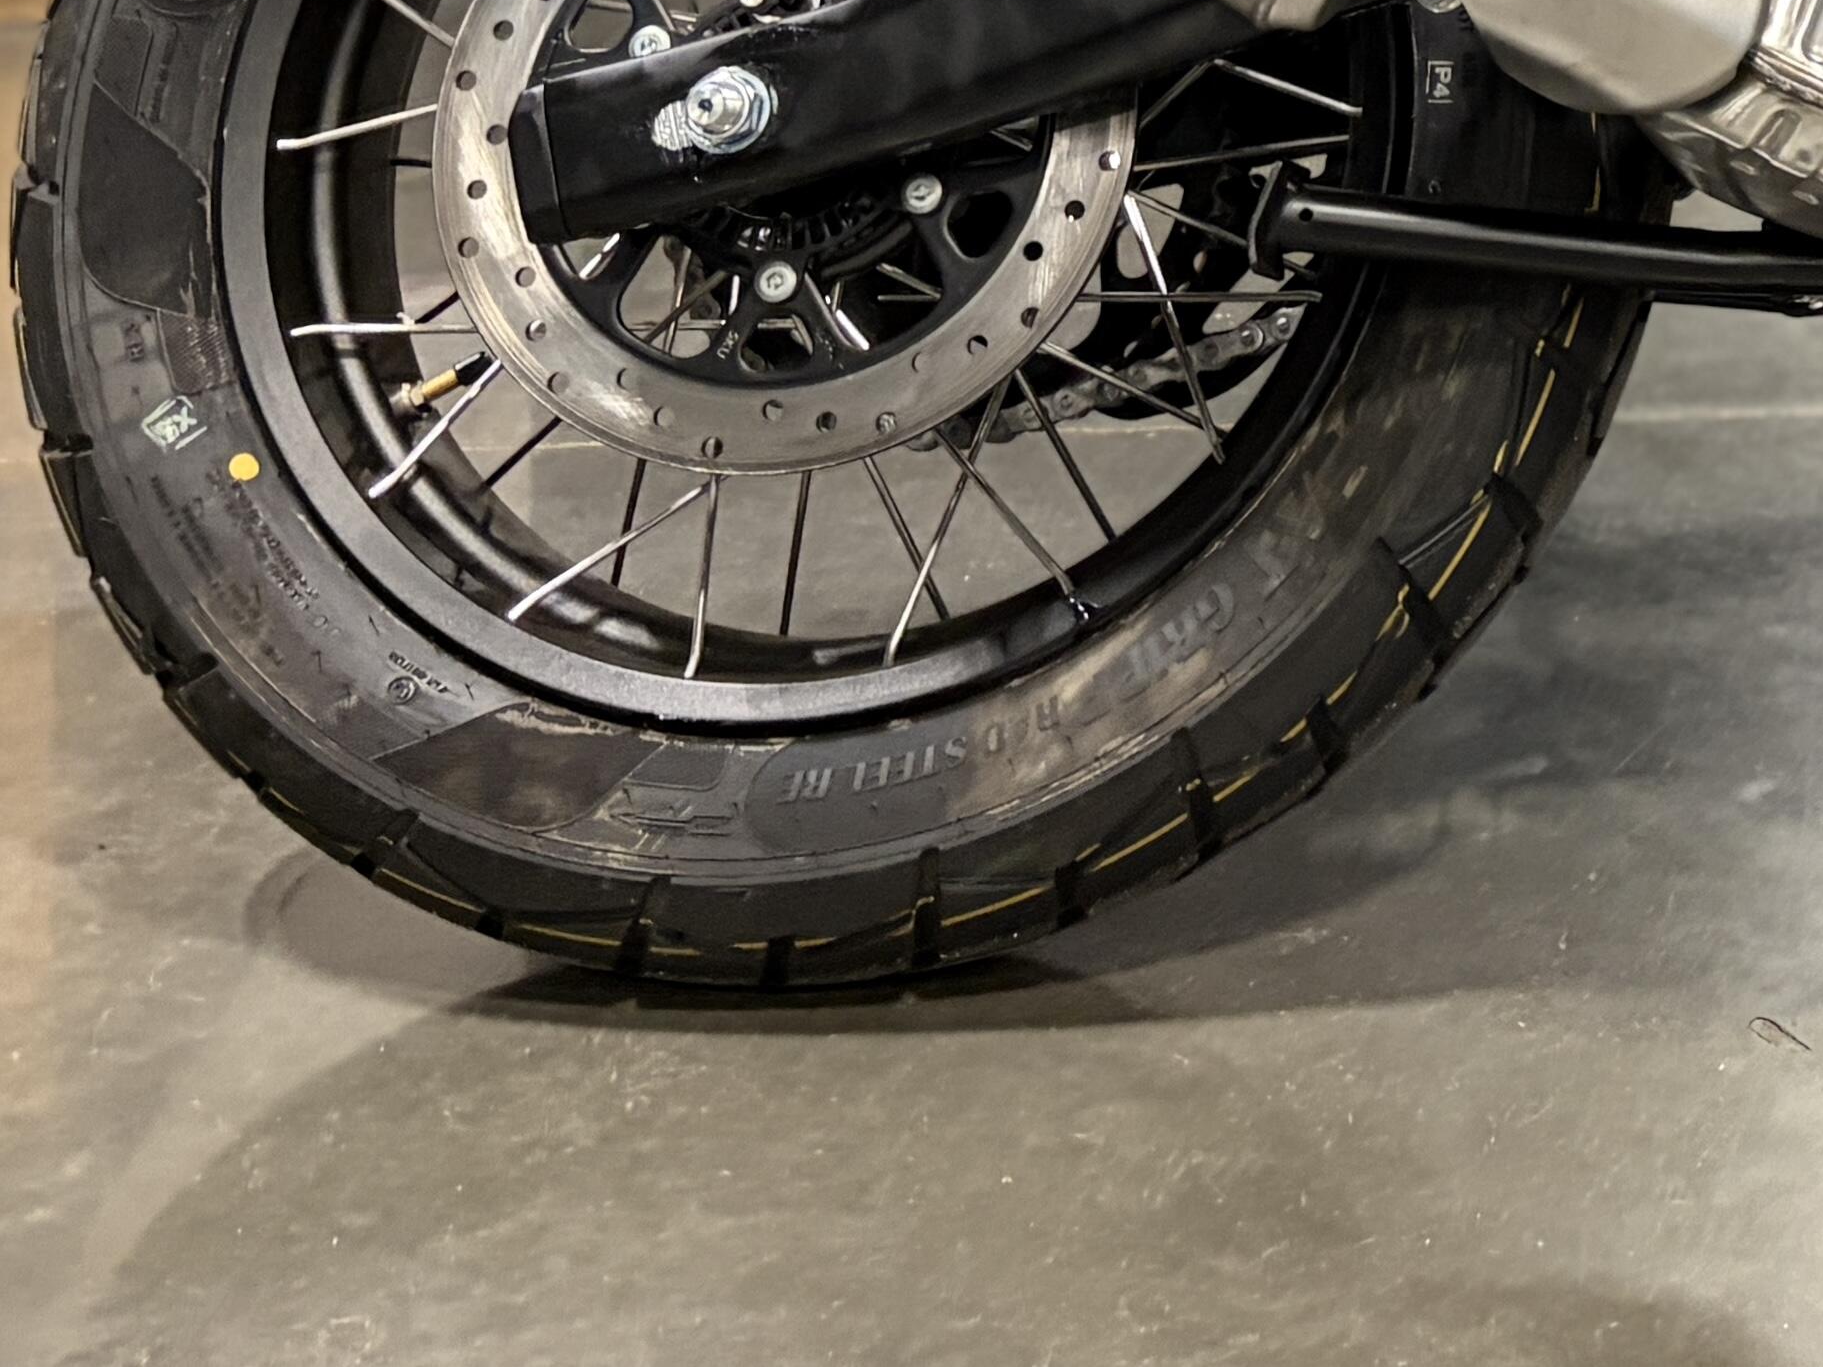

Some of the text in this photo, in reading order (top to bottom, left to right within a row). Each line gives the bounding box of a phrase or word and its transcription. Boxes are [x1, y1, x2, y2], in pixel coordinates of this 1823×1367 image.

[1432, 66, 1453, 99] P4
[850, 734, 967, 793] STEEL
[775, 767, 833, 805] RE
